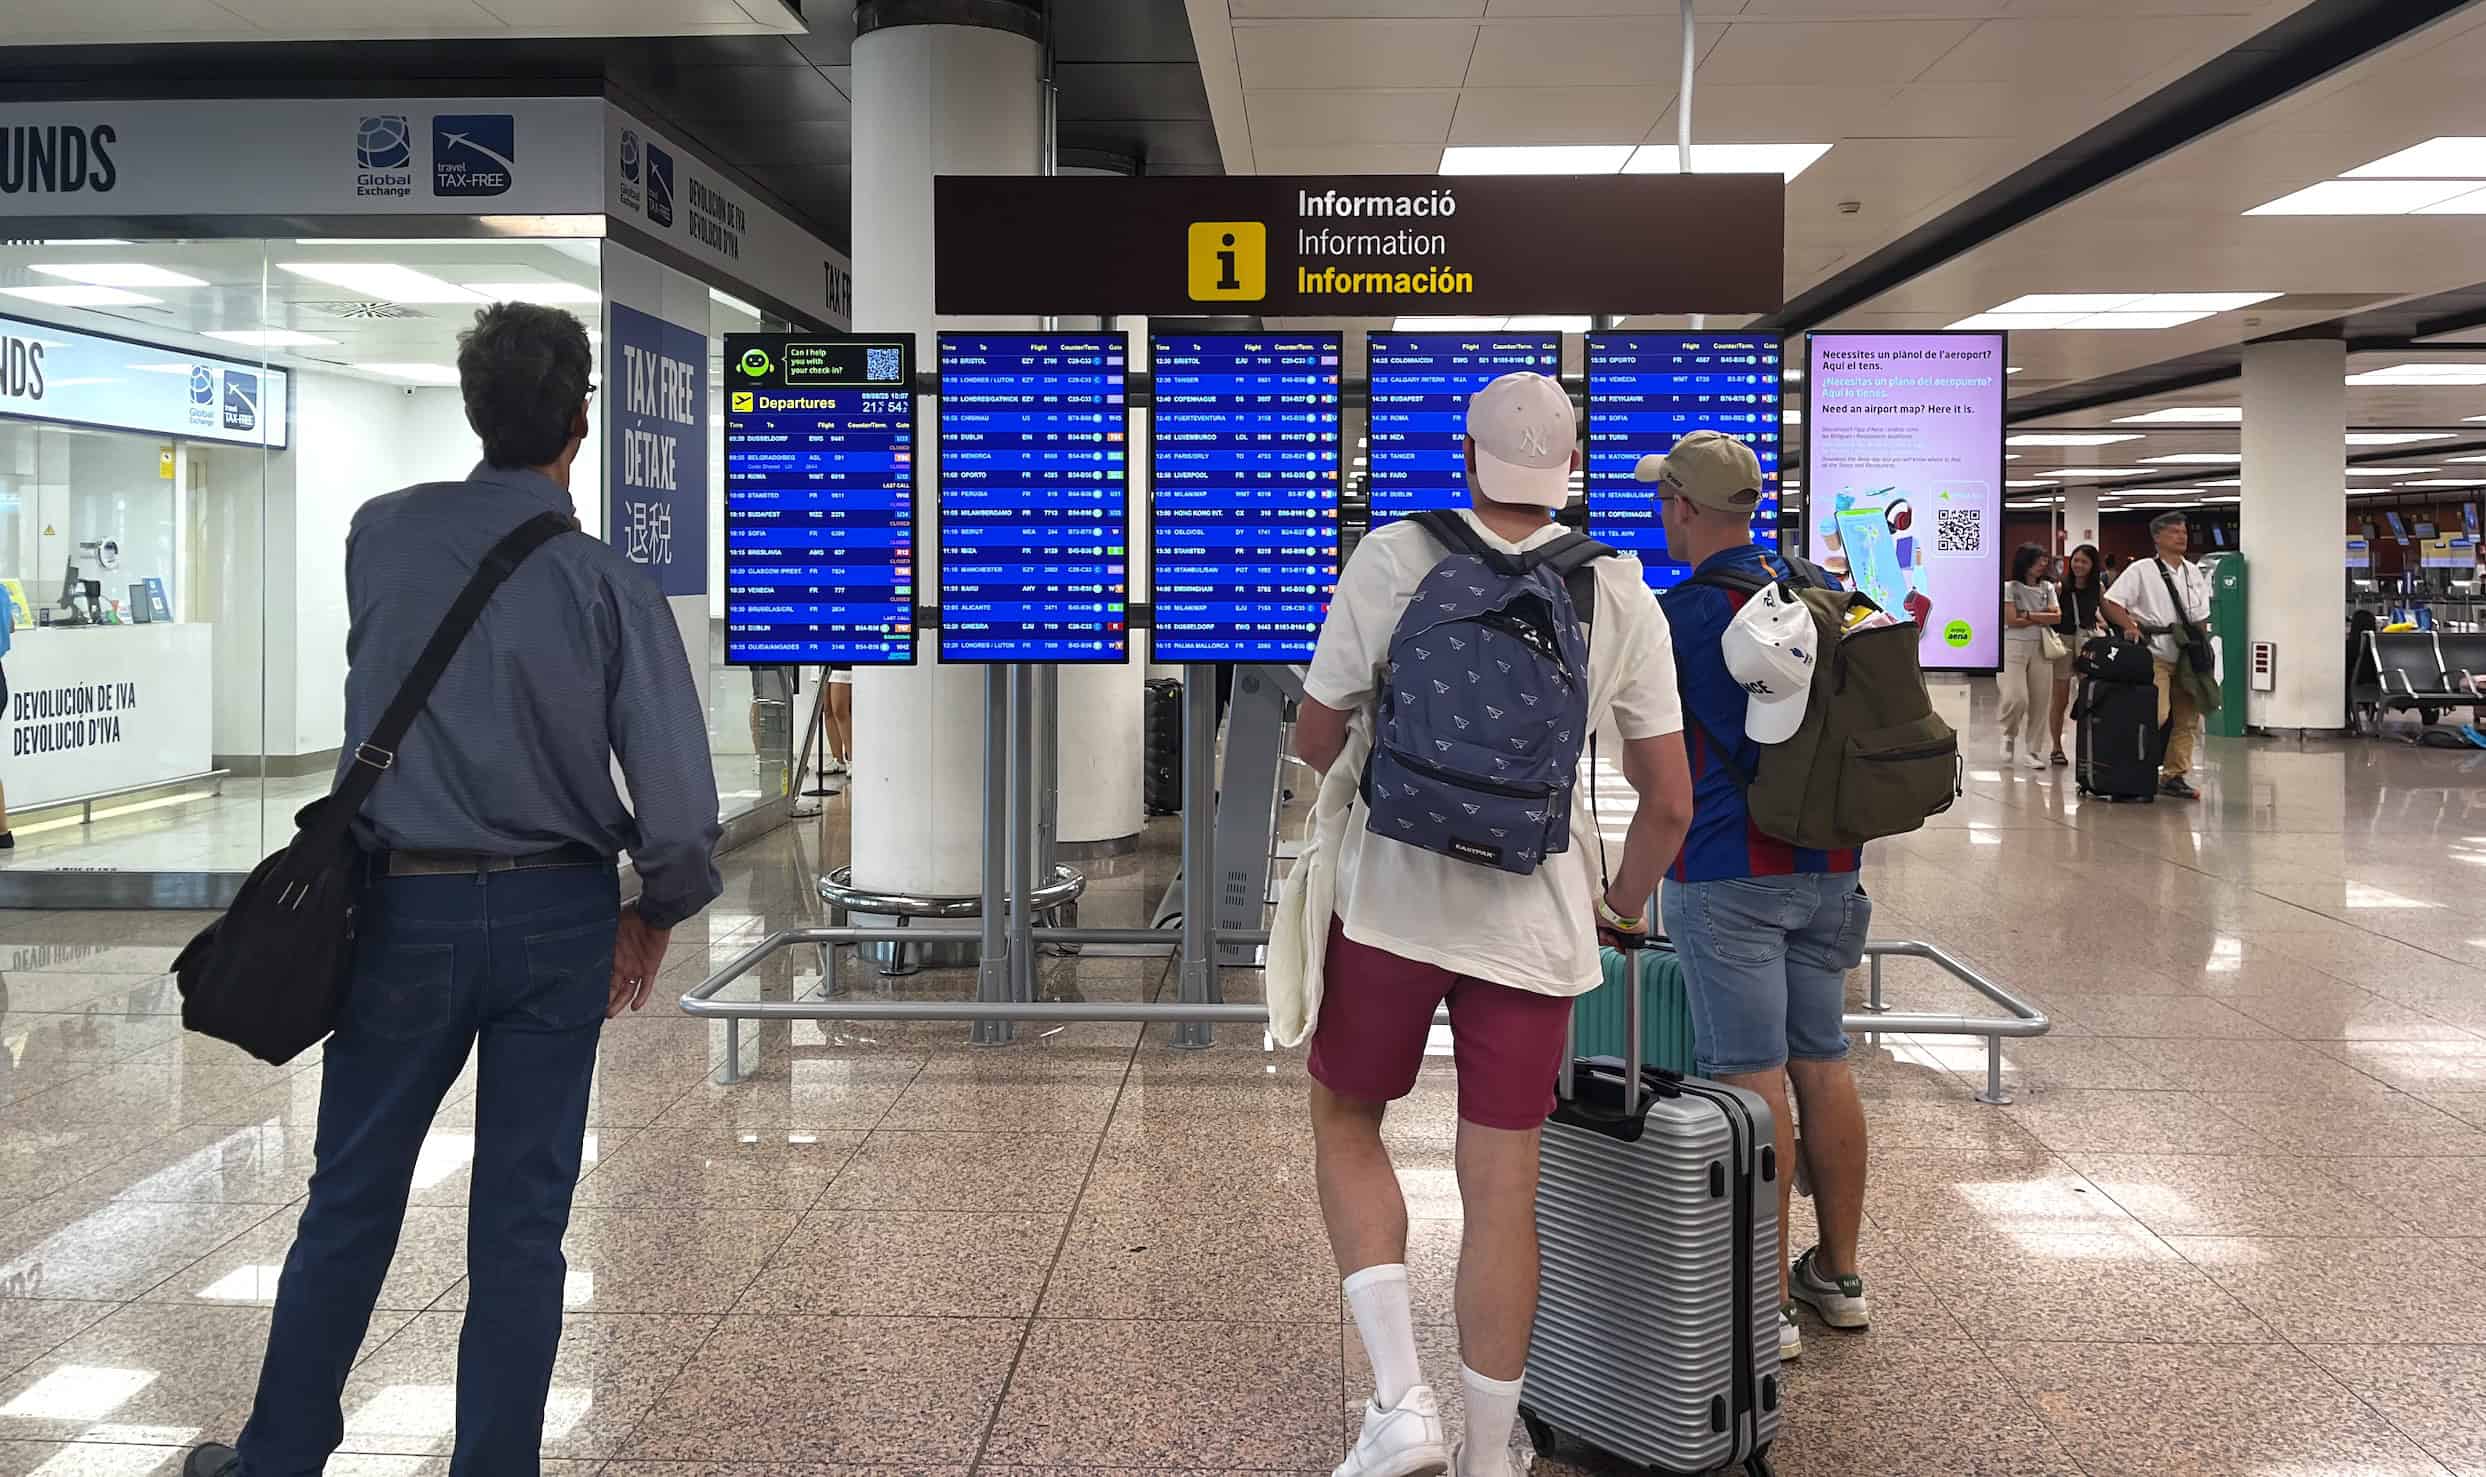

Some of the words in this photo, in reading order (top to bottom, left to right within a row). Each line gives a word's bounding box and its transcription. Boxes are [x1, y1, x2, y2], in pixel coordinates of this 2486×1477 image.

[0, 124, 116, 194] UNDS
[437, 162, 466, 173] travel
[357, 174, 410, 185] Global
[437, 173, 504, 187] TAX-FREE
[357, 186, 410, 198] Exchange
[1298, 189, 1456, 218] Informació
[1298, 228, 1446, 258] Information
[824, 260, 840, 315] TAX
[1298, 265, 1473, 296] Información
[791, 349, 803, 357] Can
[809, 349, 826, 359] help
[806, 357, 824, 365] with
[1823, 350, 1875, 359] Necessites
[1893, 350, 1922, 362] plànol
[1925, 350, 1937, 359] de
[1939, 350, 1992, 362] l'aeroport?
[791, 367, 807, 376] your
[1822, 361, 1845, 372] Aquí
[1847, 361, 1856, 369] el
[1859, 362, 1883, 370] tens.
[623, 344, 657, 416] TAX
[660, 355, 694, 425] FREE
[759, 395, 836, 412] Departures
[1822, 405, 1848, 413] Need
[1864, 405, 1897, 416] airport
[1900, 405, 1925, 416] map?
[1928, 405, 1951, 413] Here
[1954, 405, 1961, 413] it
[1963, 405, 1975, 413] is.
[624, 419, 677, 490] DÉTAXE
[1390, 471, 1407, 479] FARO
[624, 500, 672, 565] 退税
[14, 682, 93, 722] DEVOLUCIÓN
[97, 684, 112, 712] DE
[116, 682, 136, 710] IVA
[14, 715, 84, 757] DEVOLUCIÓ
[89, 715, 120, 746] D'IVA
[1455, 843, 1494, 859] EASTPAK
